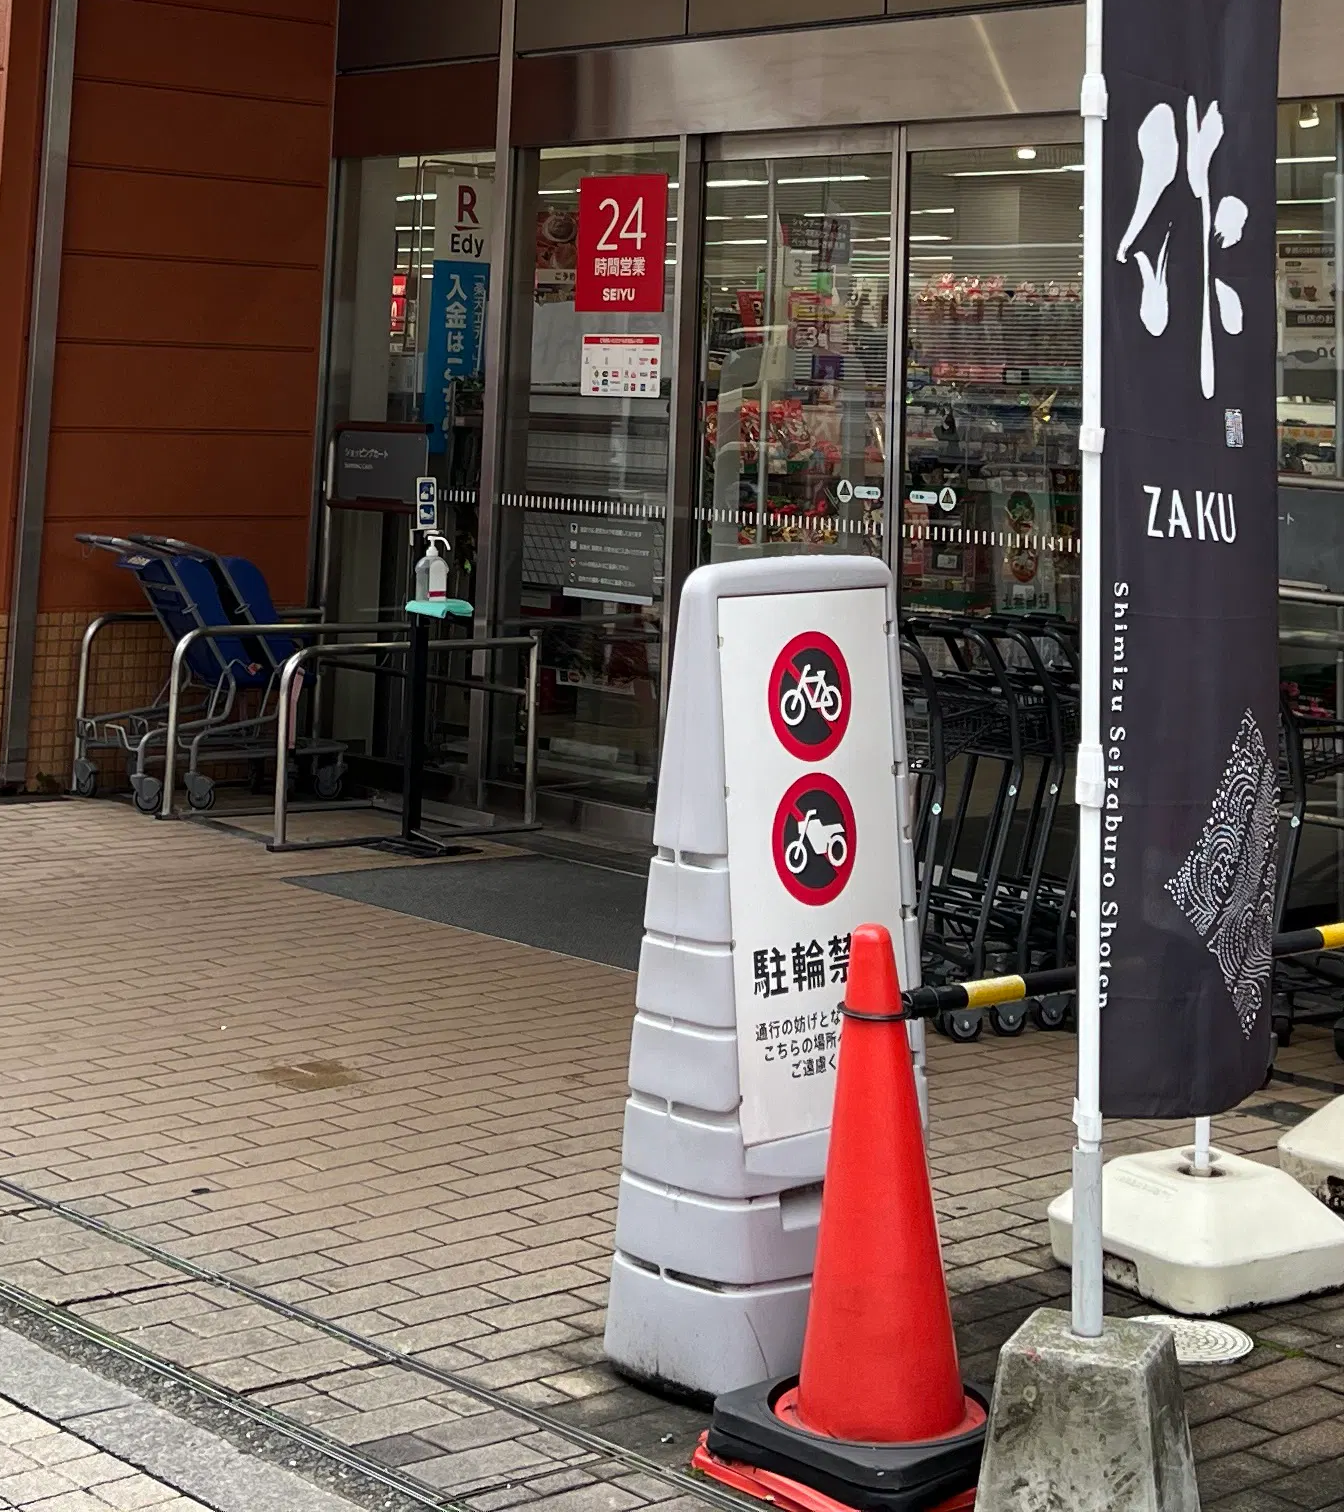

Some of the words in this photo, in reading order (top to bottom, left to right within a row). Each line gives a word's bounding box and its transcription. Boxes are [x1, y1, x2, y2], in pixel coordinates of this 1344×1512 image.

[457, 184, 481, 224] R
[596, 196, 647, 252] 24
[450, 233, 485, 259] Edy
[594, 256, 646, 278] 時間営業
[602, 287, 636, 302] SEIYU
[1142, 485, 1236, 543] ZAKU
[1110, 581, 1129, 712] Shimizu
[1103, 726, 1127, 888] Seizaburo
[753, 933, 852, 999] 駐輪禁
[791, 1053, 837, 1079] ご遠慮く
